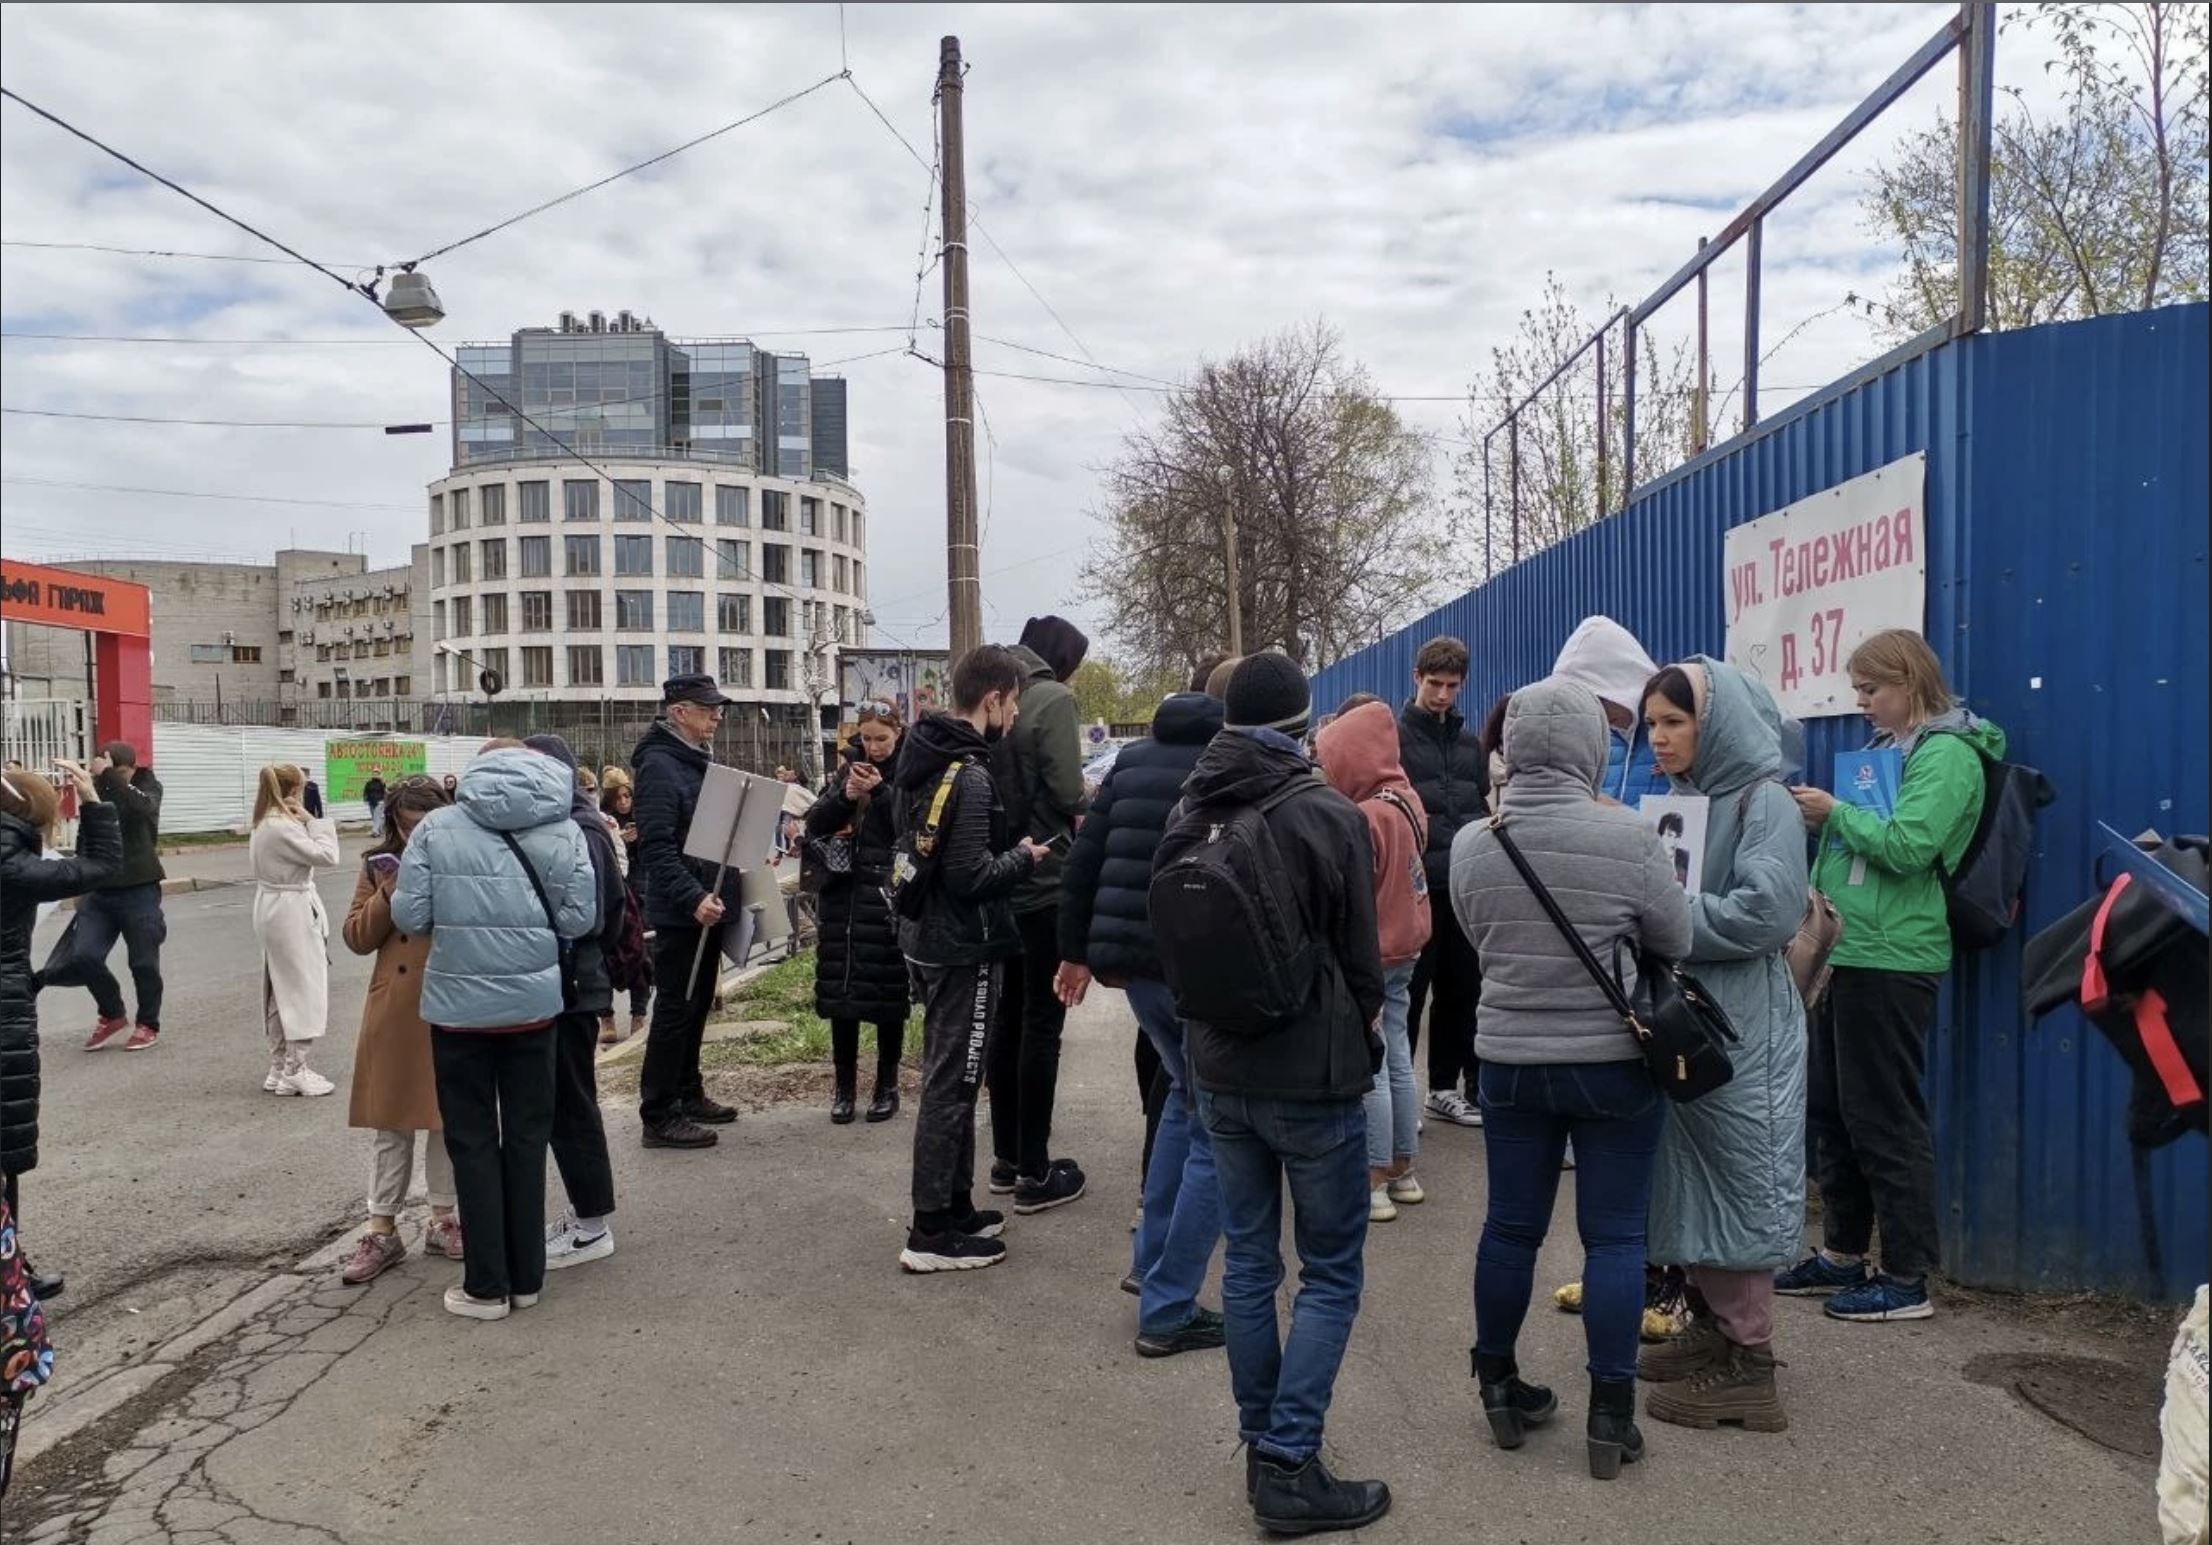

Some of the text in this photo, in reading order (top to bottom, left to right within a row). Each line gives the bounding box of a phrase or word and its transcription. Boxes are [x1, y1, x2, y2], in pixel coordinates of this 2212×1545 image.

[1731, 507, 1914, 621] ул. Тележная
[1780, 608, 1844, 691] д. 37
[973, 980, 989, 1020] SQUAD
[963, 1021, 986, 1084] PROJECTS
